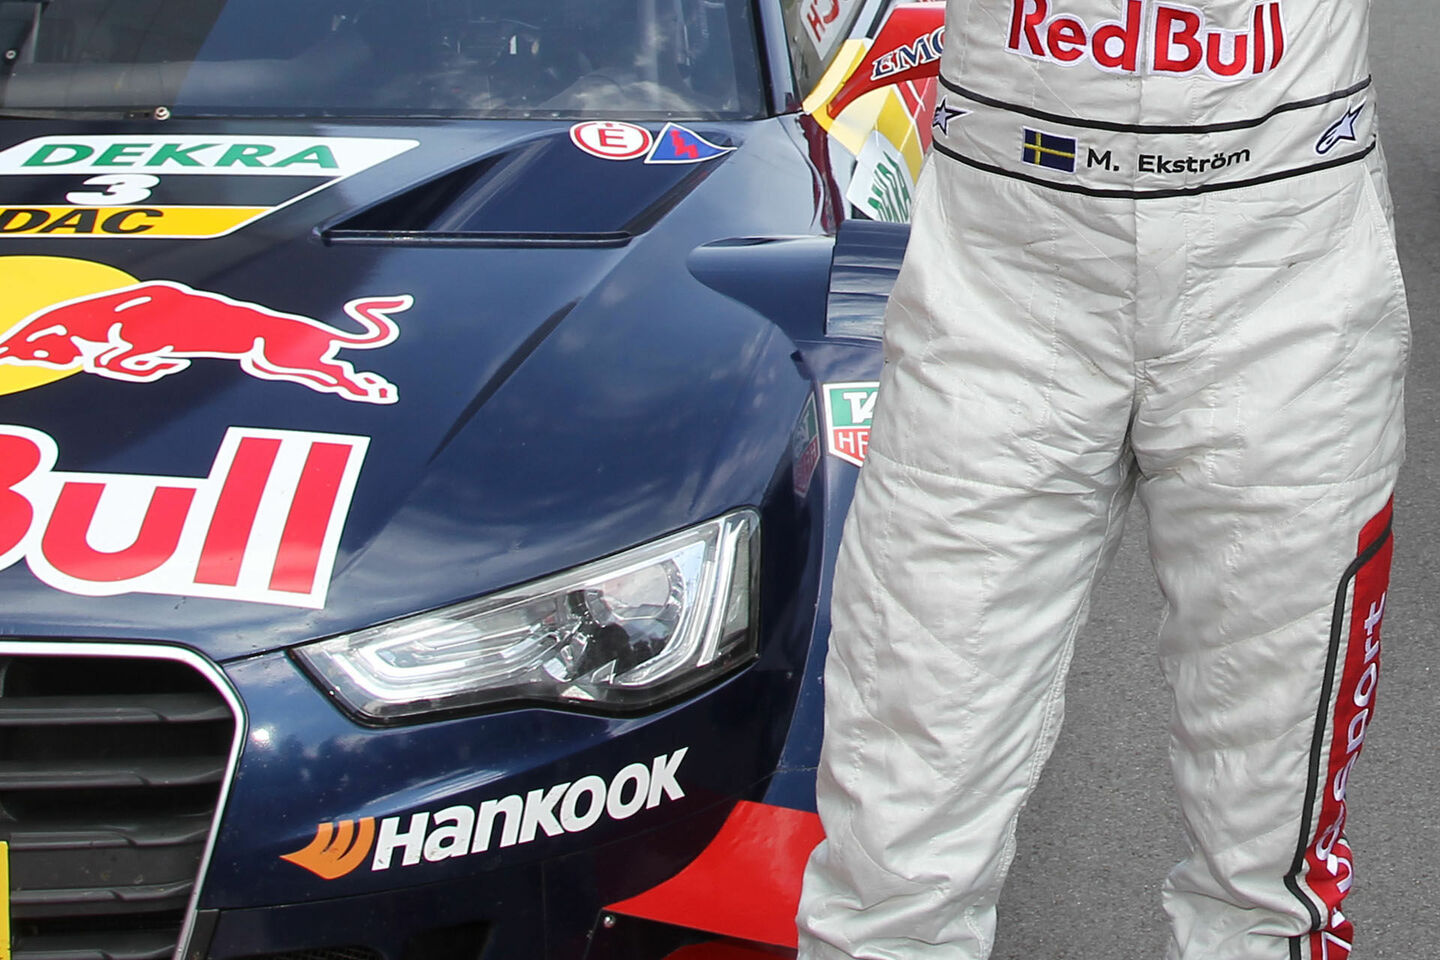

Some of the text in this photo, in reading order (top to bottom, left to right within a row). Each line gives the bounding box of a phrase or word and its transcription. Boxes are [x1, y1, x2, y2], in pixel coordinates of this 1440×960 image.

[20, 143, 340, 169] DEKRA
[1087, 147, 1251, 174] M. Ekström
[65, 173, 160, 205] 3
[0, 209, 164, 233] DAC
[1333, 591, 1387, 802] Sport
